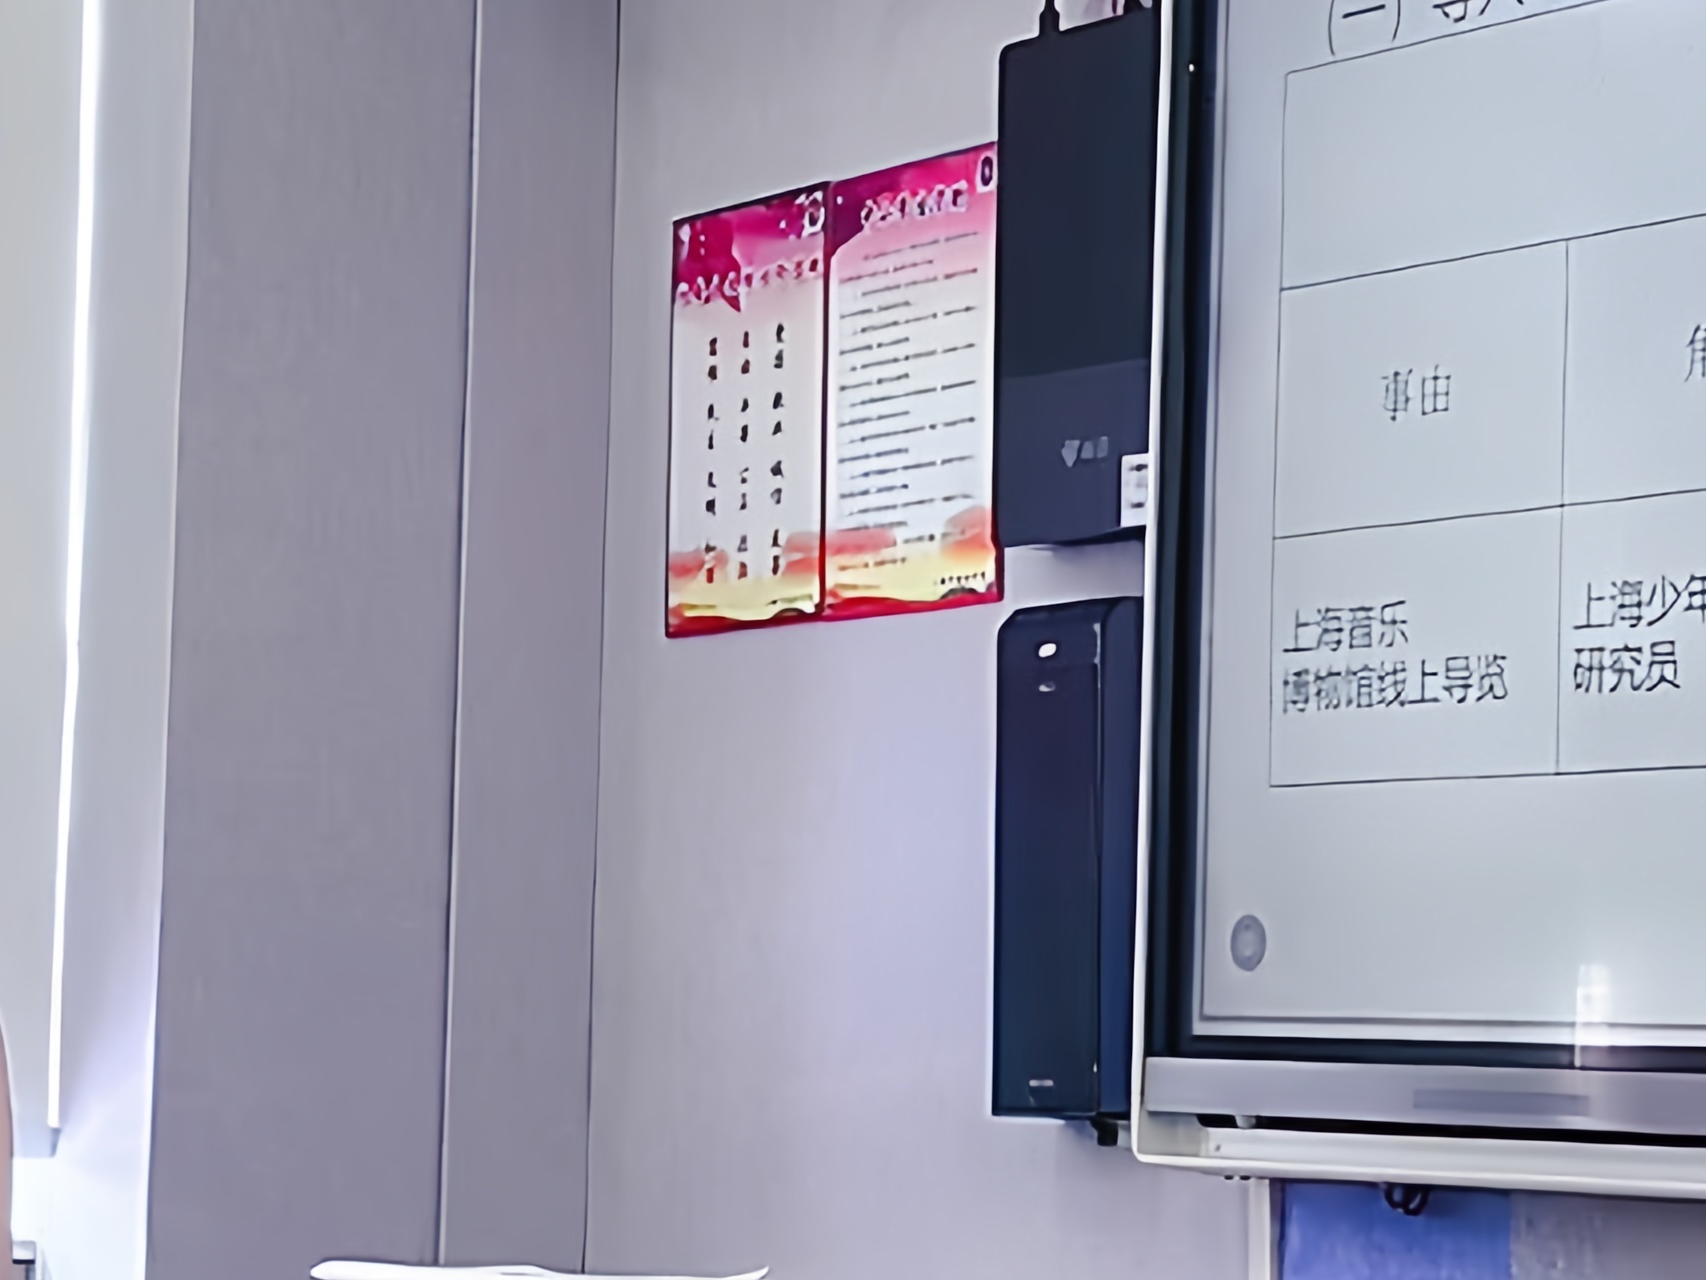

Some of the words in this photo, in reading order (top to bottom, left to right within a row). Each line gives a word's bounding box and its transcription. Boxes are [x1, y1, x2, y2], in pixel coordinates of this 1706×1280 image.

[1282, 600, 1409, 652] 上海音乐
[1573, 640, 1681, 694] 研究员
